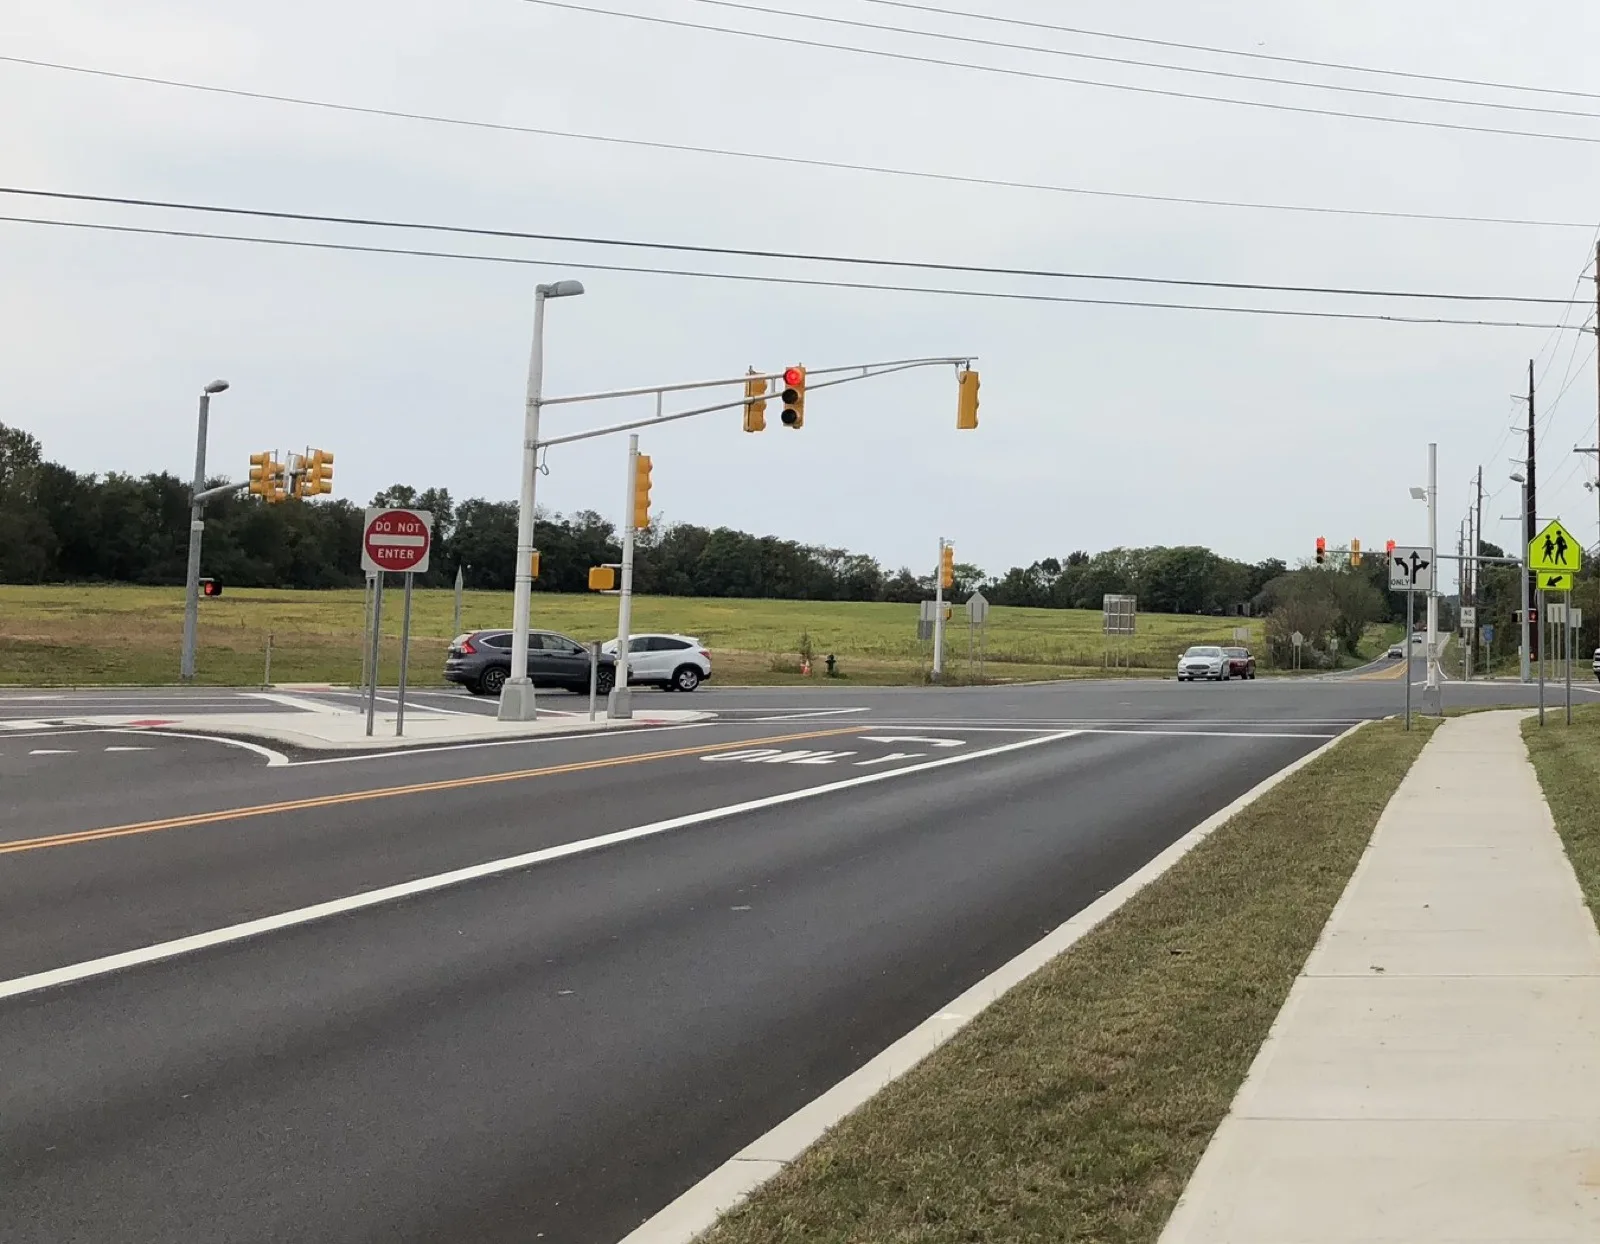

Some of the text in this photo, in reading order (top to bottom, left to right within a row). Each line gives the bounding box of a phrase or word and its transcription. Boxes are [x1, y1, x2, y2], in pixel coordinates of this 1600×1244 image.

[376, 521, 421, 533] DO NOT
[377, 548, 414, 559] ENTER
